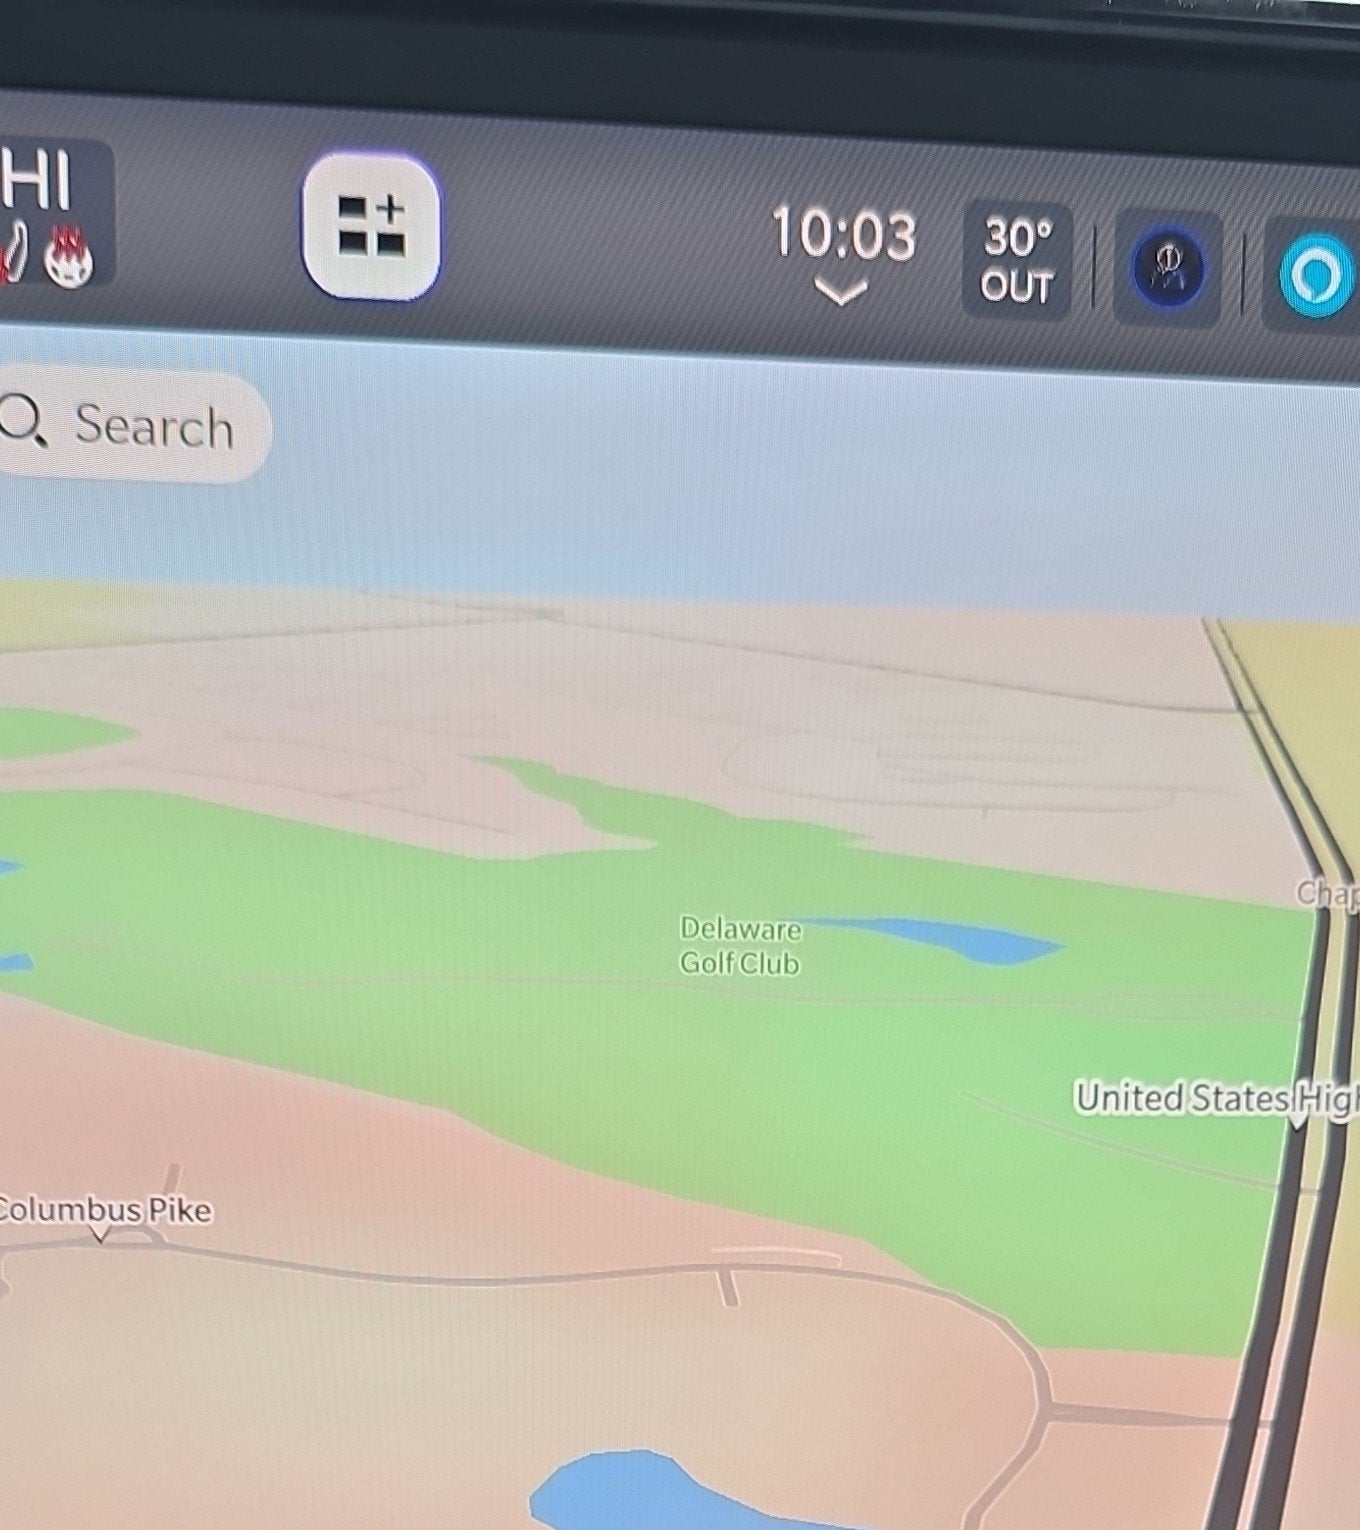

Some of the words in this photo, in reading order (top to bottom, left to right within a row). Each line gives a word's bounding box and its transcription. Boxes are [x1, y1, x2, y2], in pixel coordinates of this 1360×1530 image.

[1, 147, 71, 211] HI
[773, 205, 917, 261] 10:03
[984, 217, 1054, 257] 30°
[980, 268, 1055, 305] OUT
[76, 402, 235, 451] Search
[681, 916, 802, 940] Delaware
[681, 951, 737, 974] Golf
[741, 952, 799, 975] Club
[1078, 1084, 1183, 1110] United
[1193, 1085, 1288, 1110] States
[150, 1198, 211, 1222] Pike
